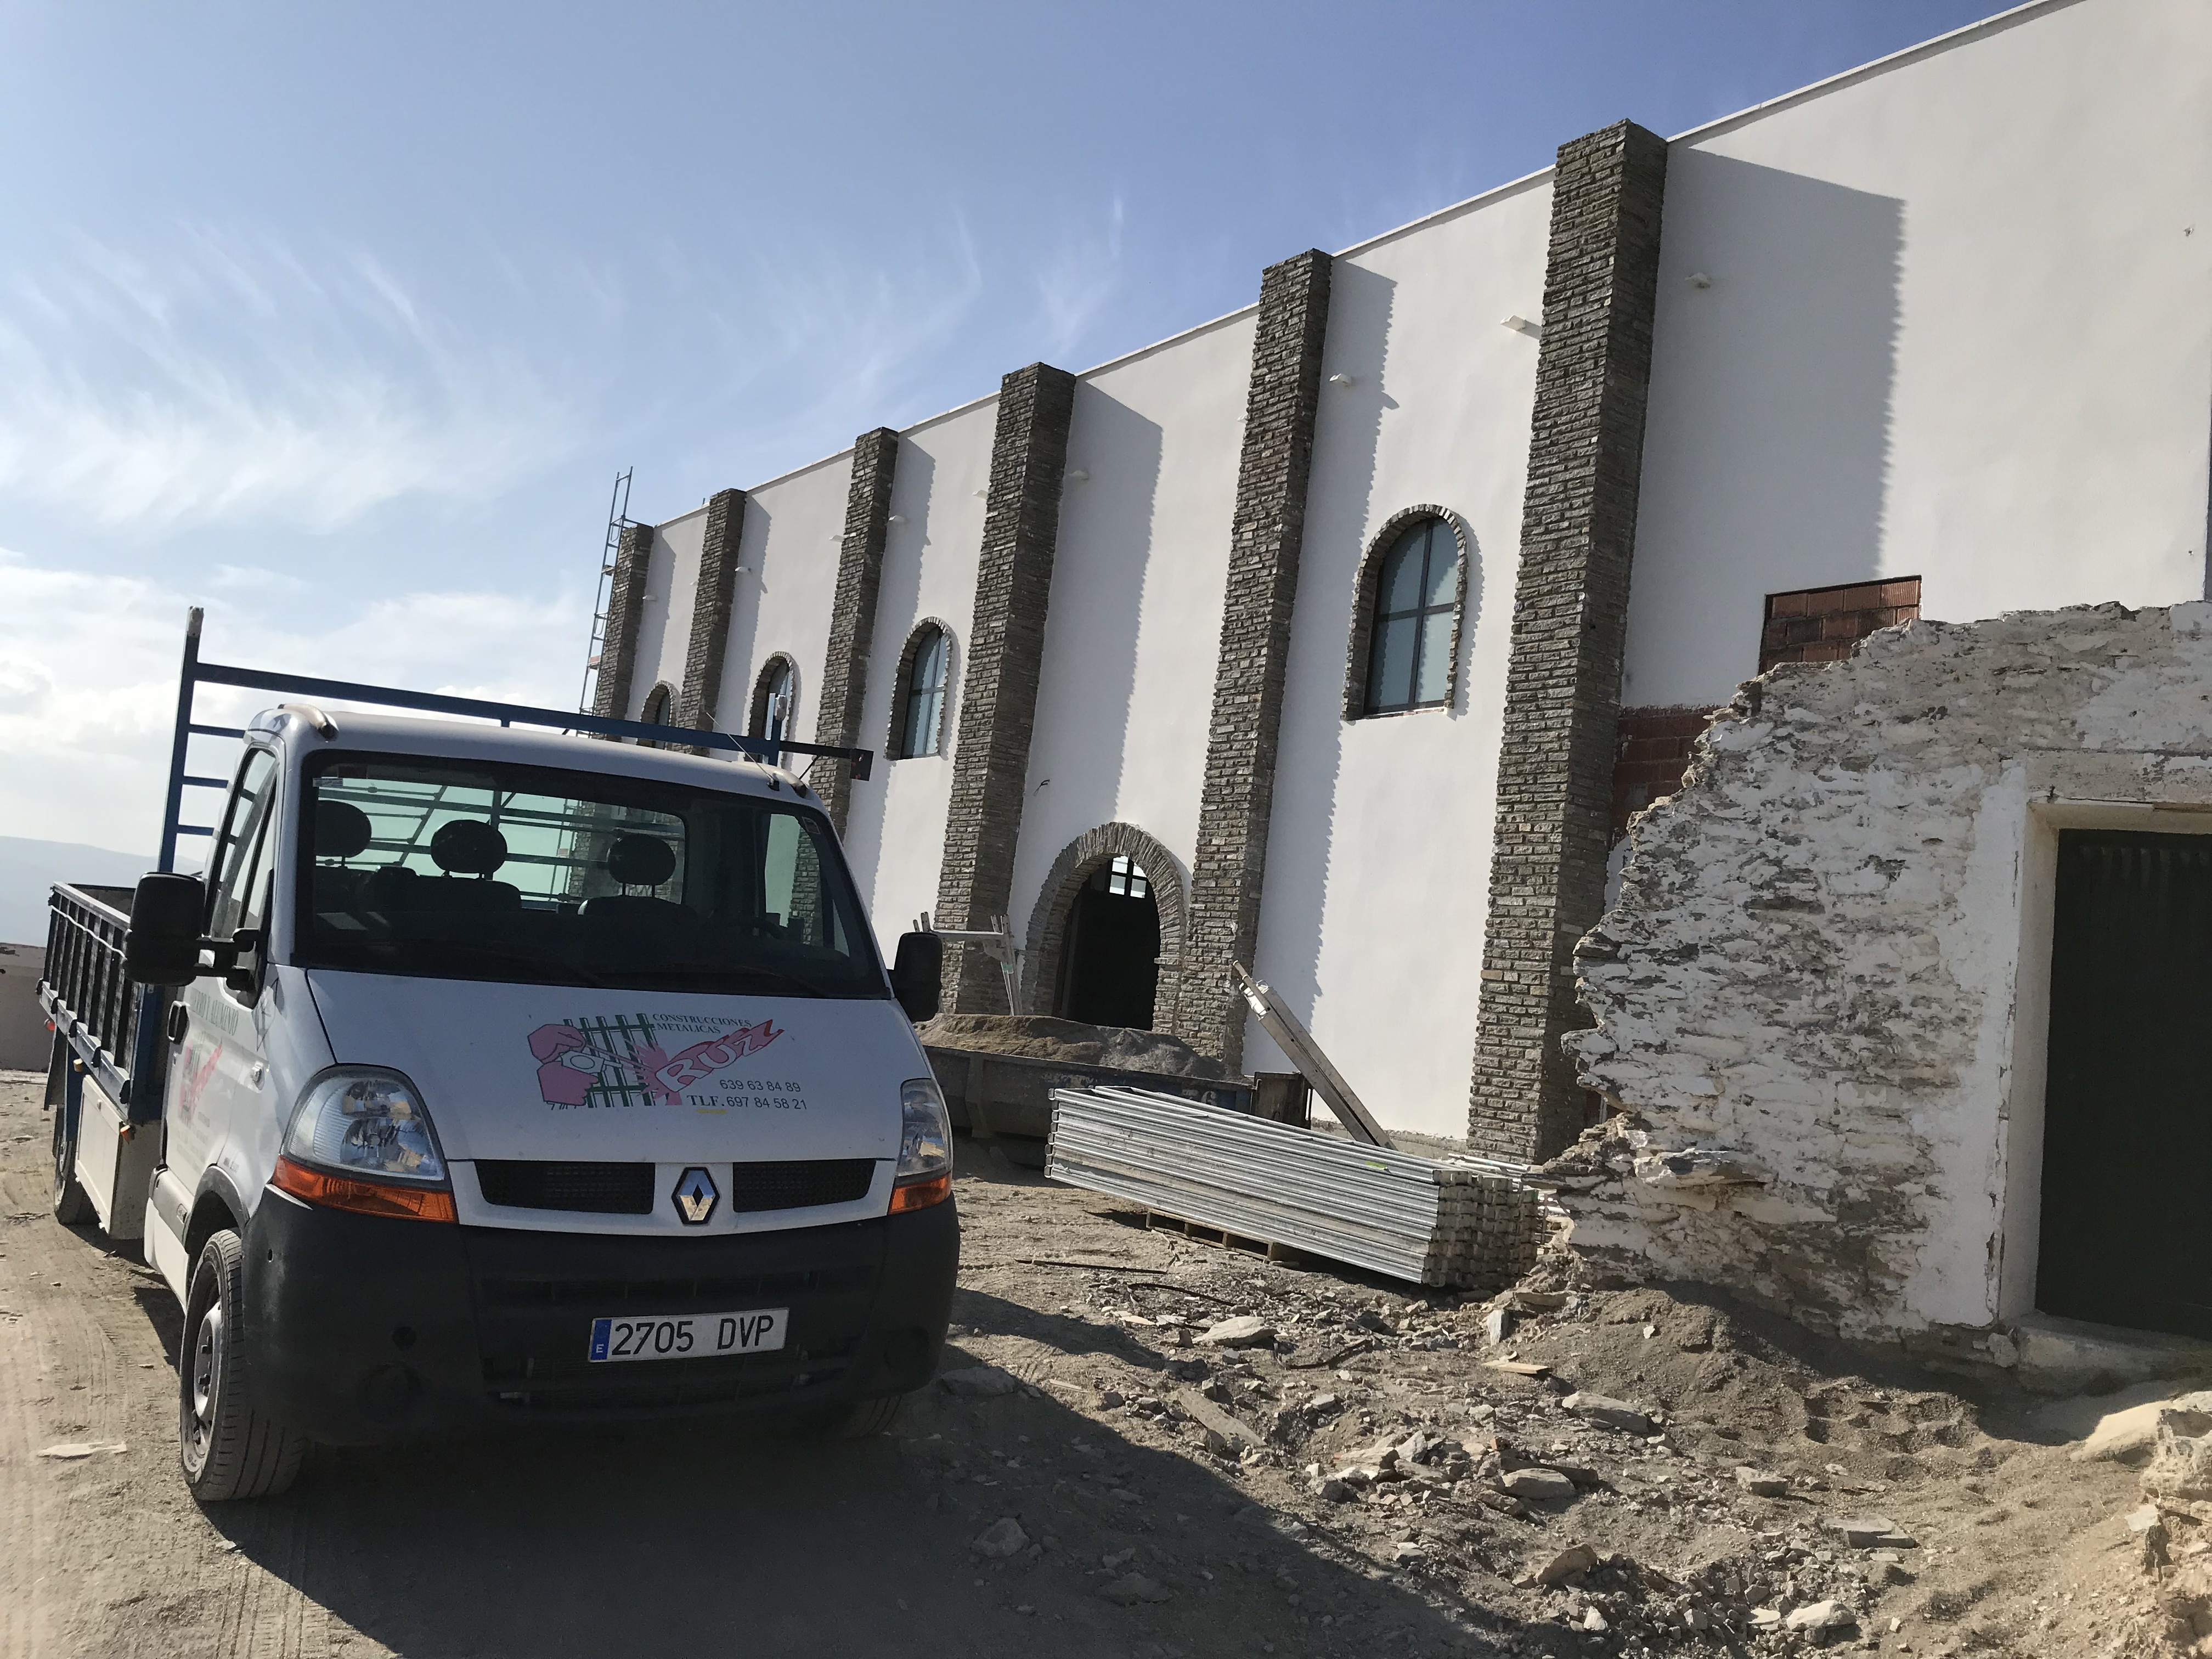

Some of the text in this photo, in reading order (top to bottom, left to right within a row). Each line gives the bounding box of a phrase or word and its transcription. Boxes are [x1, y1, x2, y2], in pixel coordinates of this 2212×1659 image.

[652, 1013, 752, 1027] CONSTRUCCIONES
[657, 1023, 721, 1034] METALICAS
[654, 1022, 780, 1092] RUZ
[719, 1079, 801, 1092] 639 63 84 89
[686, 1095, 807, 1110] TLF. 697 84 58 21
[595, 1315, 774, 1356] E 2705 DVP
